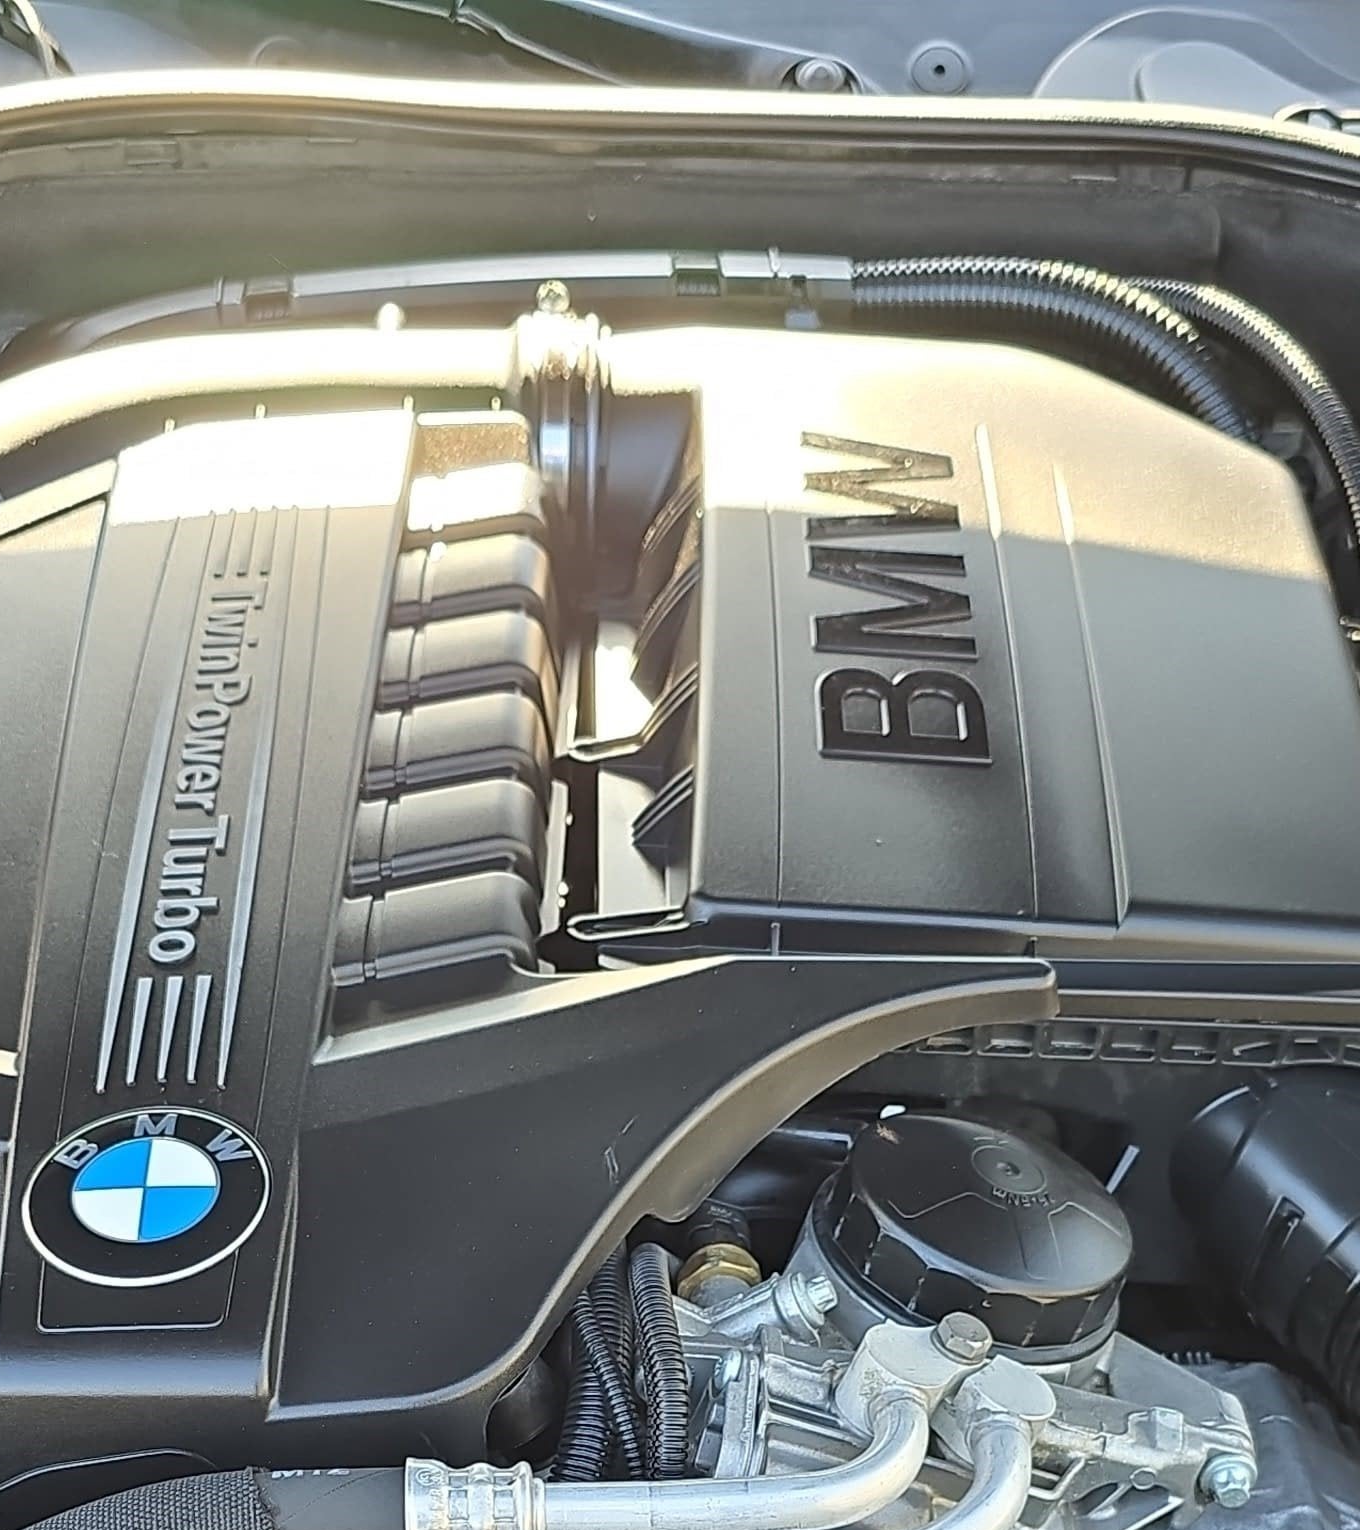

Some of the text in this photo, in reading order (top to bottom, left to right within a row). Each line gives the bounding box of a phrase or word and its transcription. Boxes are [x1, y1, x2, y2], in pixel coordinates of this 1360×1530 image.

[800, 430, 993, 766] BMW
[149, 581, 269, 966] TwinPower Turbo
[52, 1112, 252, 1170] BMW
